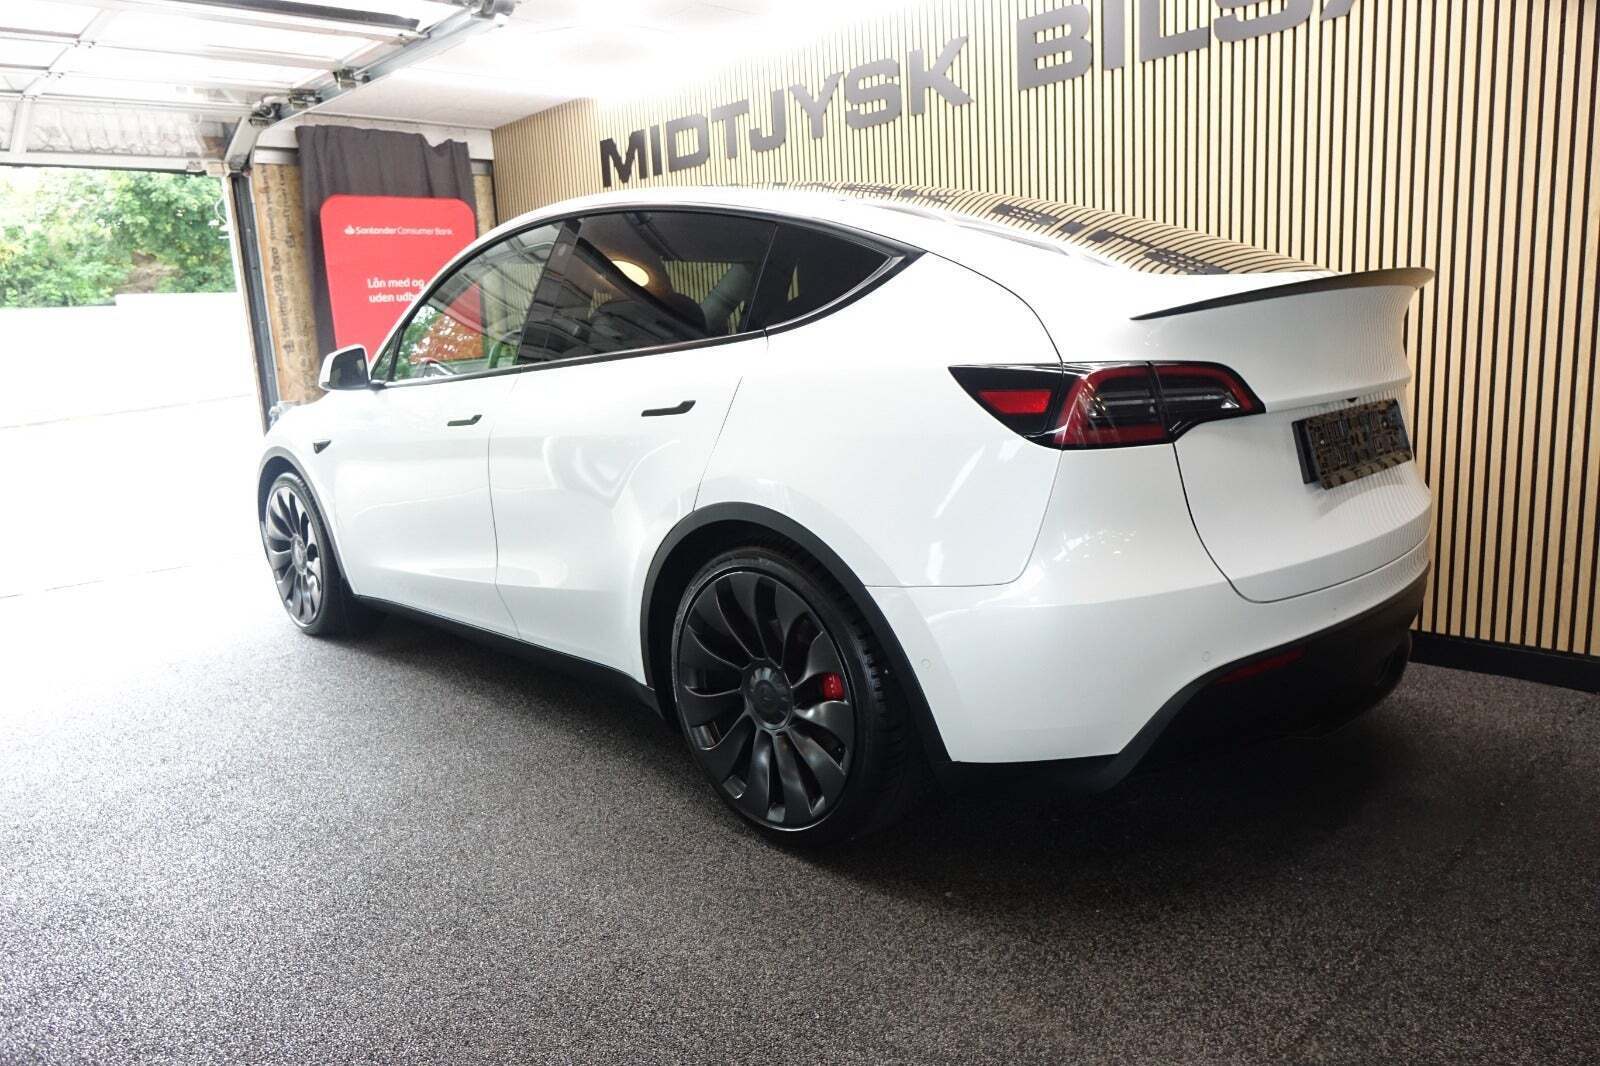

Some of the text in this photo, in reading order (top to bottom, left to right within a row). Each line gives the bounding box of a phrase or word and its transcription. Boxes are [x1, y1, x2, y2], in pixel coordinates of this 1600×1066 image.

[599, 35, 974, 188] MIDTJYSK
[355, 226, 452, 236] Santander Consumer Bank
[367, 277, 425, 290] Lån med og
[368, 292, 395, 303] uden
